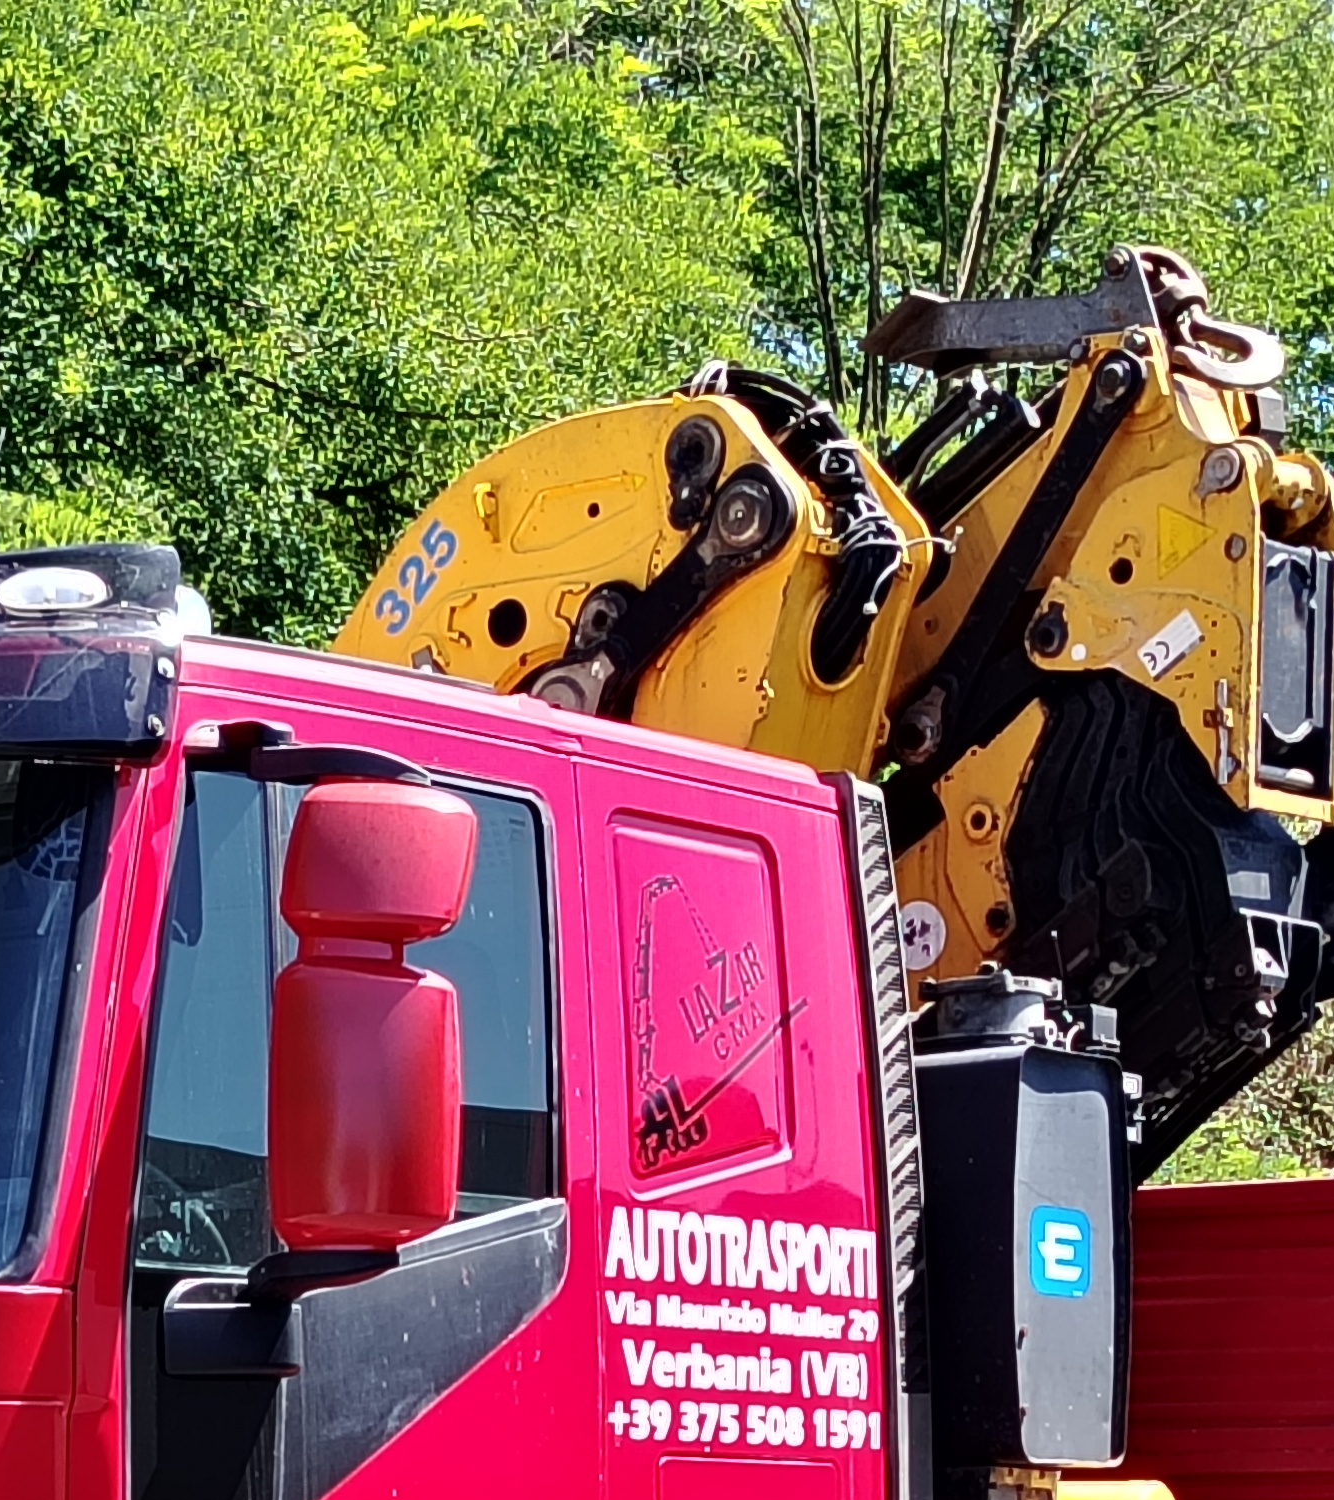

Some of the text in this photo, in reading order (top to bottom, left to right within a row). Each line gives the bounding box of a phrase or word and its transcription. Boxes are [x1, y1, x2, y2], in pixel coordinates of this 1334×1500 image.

[374, 518, 457, 635] 325
[678, 940, 766, 1044] LAZAR
[713, 1000, 766, 1060] CMA
[605, 1206, 878, 1300] AUTOTRASPORTI
[605, 1290, 879, 1342] Via Maurizio Muller 29
[621, 1338, 868, 1400] Verbania (VB)
[607, 1399, 881, 1449] +39 375 508 1591
